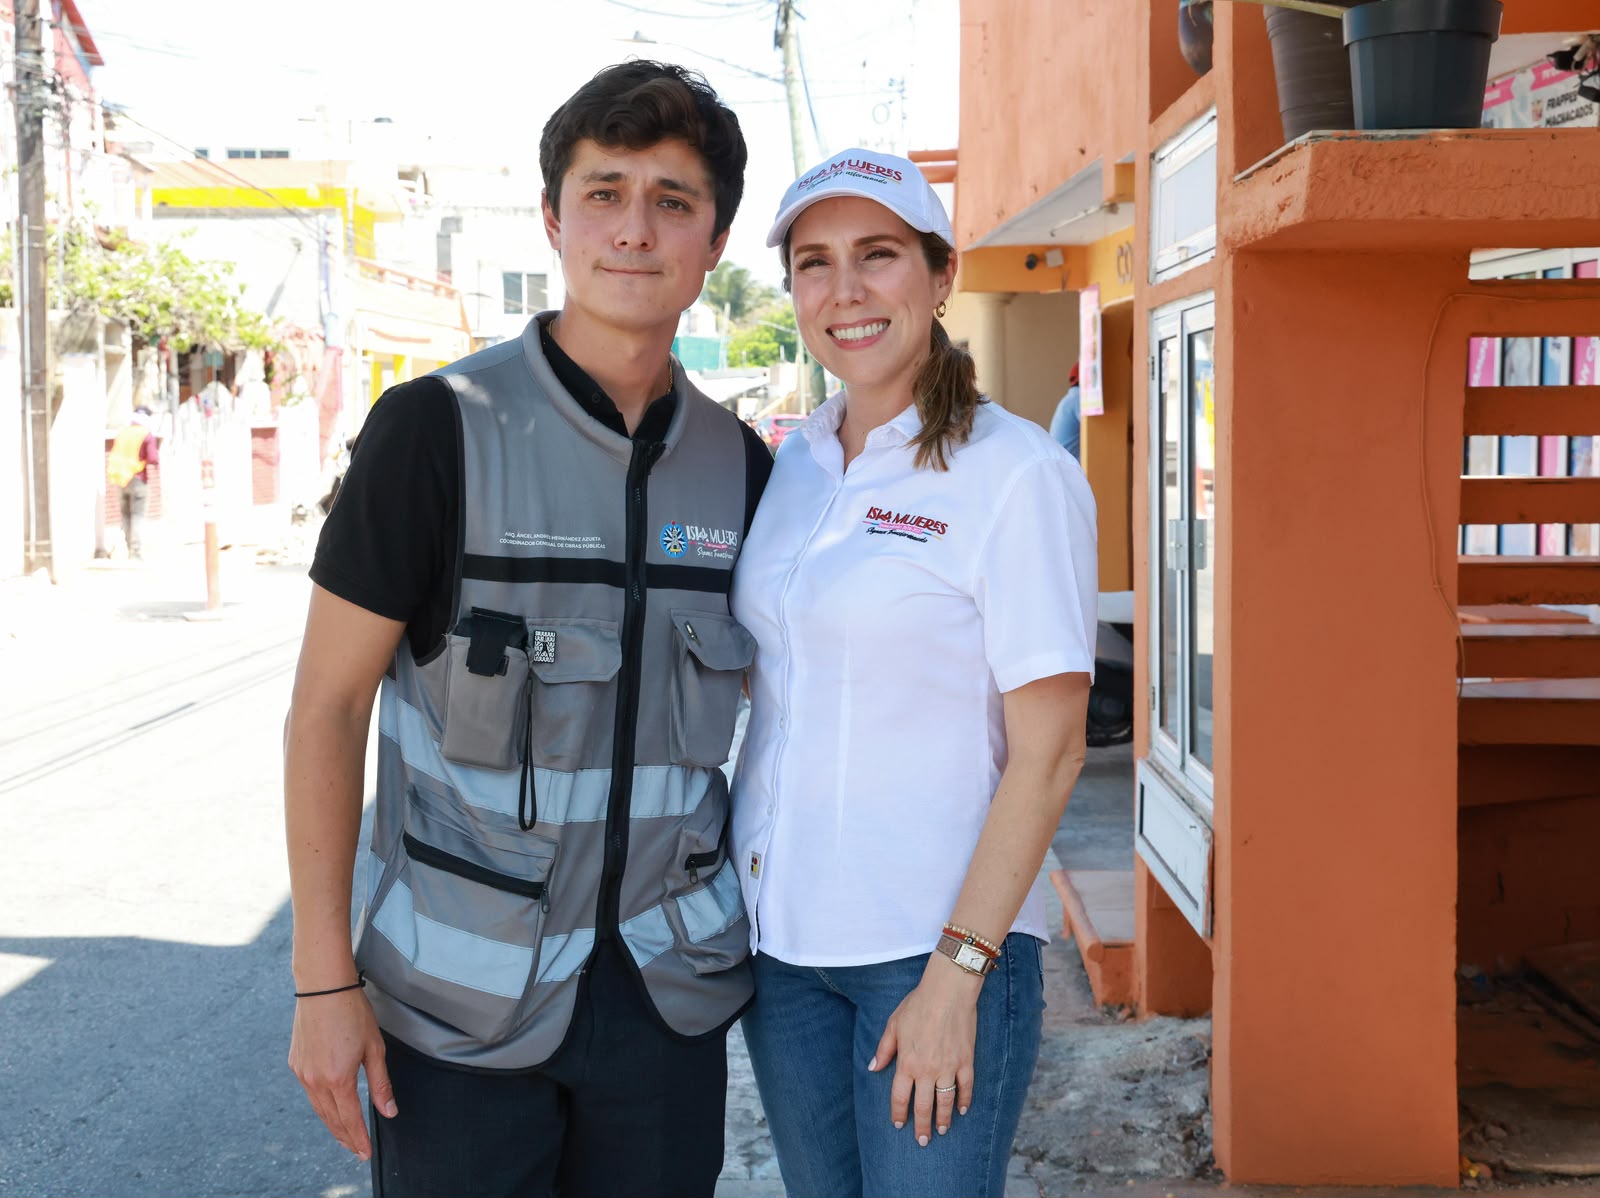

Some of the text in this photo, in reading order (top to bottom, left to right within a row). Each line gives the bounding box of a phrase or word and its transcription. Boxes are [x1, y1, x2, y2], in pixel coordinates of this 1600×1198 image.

[797, 168, 828, 190] ISLA
[830, 159, 902, 182] MUJERES
[866, 506, 892, 523] ISLA
[892, 513, 949, 535] MUJERES
[499, 538, 535, 546] COORDINADOR
[686, 525, 709, 542] ISLA
